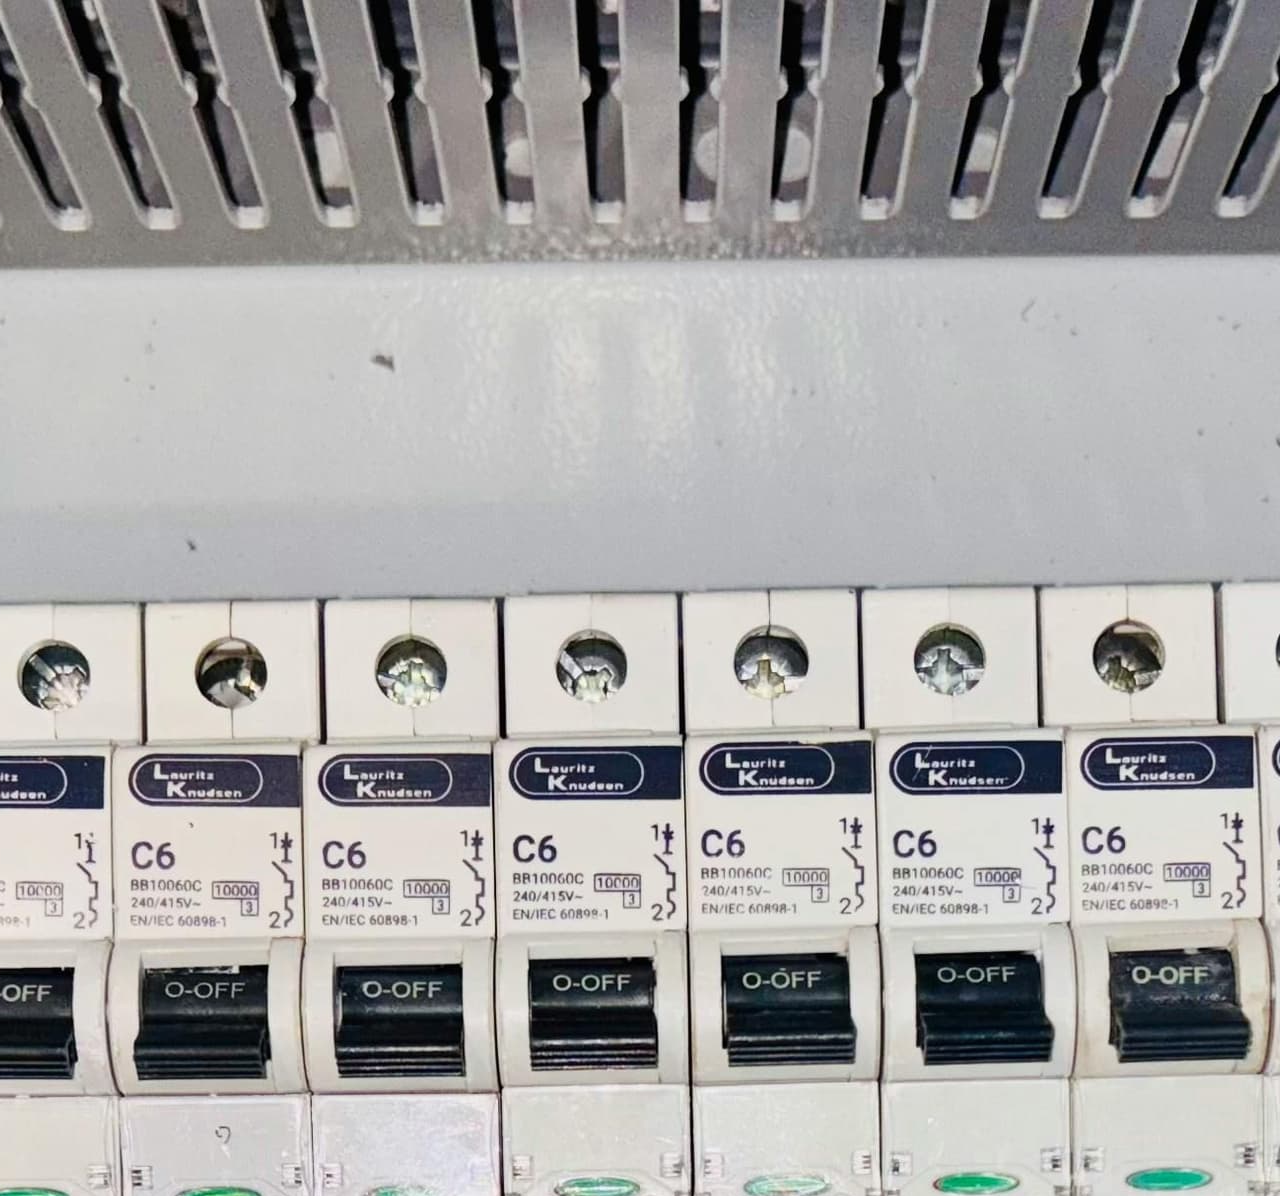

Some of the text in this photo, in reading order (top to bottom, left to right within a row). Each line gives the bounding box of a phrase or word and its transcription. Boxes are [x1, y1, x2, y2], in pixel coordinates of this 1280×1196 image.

[739, 770, 814, 785] Knudsen
[167, 781, 242, 797] Knudsen
[357, 781, 431, 797] Knudsen
[701, 829, 745, 857] C6
[893, 830, 937, 858] C6
[1082, 826, 1125, 854] C6
[132, 841, 175, 869] C6
[323, 841, 366, 869] C6
[513, 835, 557, 863] C6
[702, 903, 744, 914] EN/IEC
[840, 897, 851, 914] 2
[892, 903, 936, 914] EN/IEC
[130, 915, 173, 926] EN/IEC
[269, 911, 281, 928] 2
[322, 915, 365, 925] EN/IEC
